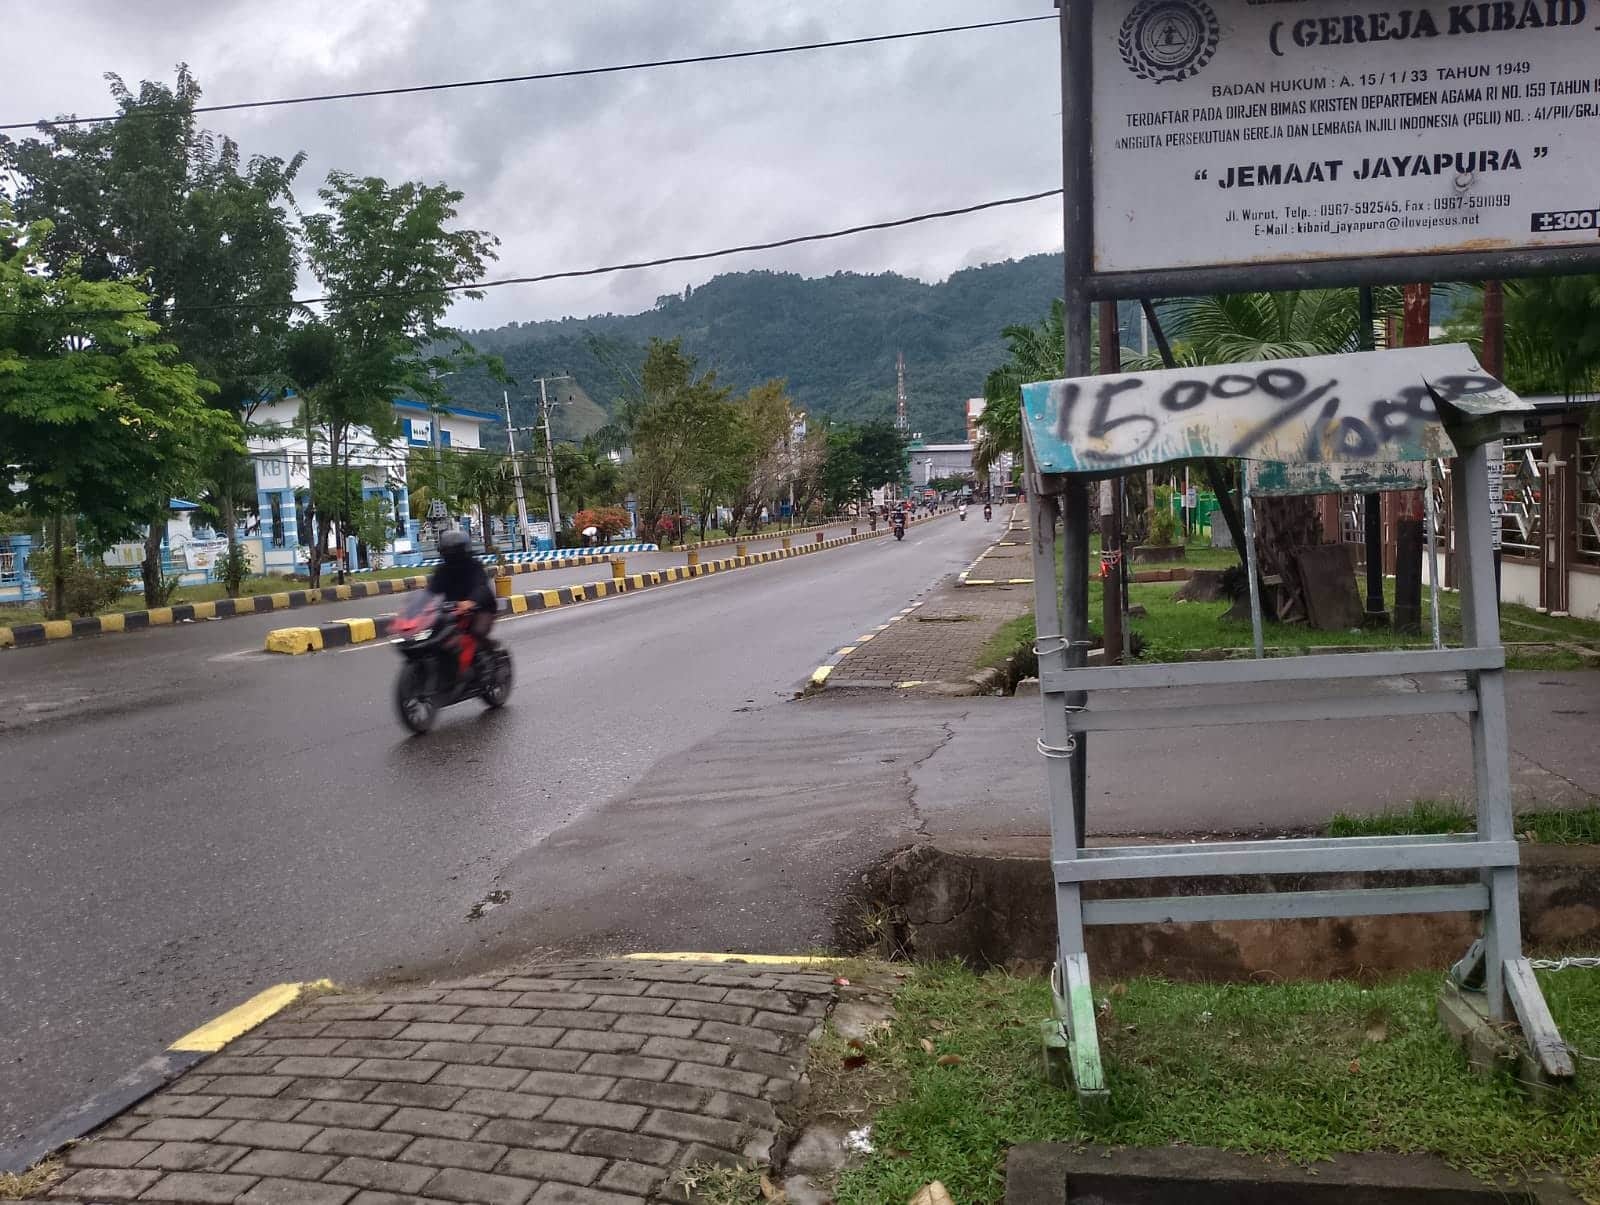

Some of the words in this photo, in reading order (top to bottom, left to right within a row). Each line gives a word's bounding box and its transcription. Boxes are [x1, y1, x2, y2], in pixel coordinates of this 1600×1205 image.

[1292, 9, 1442, 48] GEREJA
[1447, 0, 1586, 36] KIBAID
[1212, 82, 1265, 97] BADAN
[1270, 77, 1326, 93] HUKUM
[1339, 75, 1355, 88] A.
[1360, 73, 1376, 86] 15
[1410, 69, 1428, 82] 33
[1436, 64, 1490, 81] TAHUN
[1496, 61, 1531, 76] 1949
[1126, 108, 1190, 127] TERDAFTAR
[1192, 107, 1223, 123] PADA
[1226, 102, 1267, 120] DIRJEN
[1270, 100, 1307, 117] BIMAS
[1310, 96, 1358, 113] KRISTEN
[1361, 90, 1438, 110] DEPARTEMEN
[1441, 87, 1482, 105] AGAMA
[1486, 86, 1498, 101] RI
[1501, 84, 1522, 100] NO.
[1525, 82, 1546, 98] 159
[1550, 79, 1590, 97] TAHUN
[1165, 128, 1240, 147] PERSEKUTUAN
[1243, 125, 1284, 142] GEREJA
[1287, 123, 1309, 139] DAN
[1312, 120, 1362, 136] LEMBAGA
[1365, 117, 1397, 133] INJILI
[1400, 113, 1459, 130] INDONESIA
[1504, 108, 1524, 124] NO.
[1218, 160, 1343, 189] JEMAAT
[1353, 148, 1522, 180] JAYAPURA
[1225, 209, 1239, 222] Jl.
[1405, 200, 1424, 213] Fax
[1254, 223, 1288, 236] E-Mail
